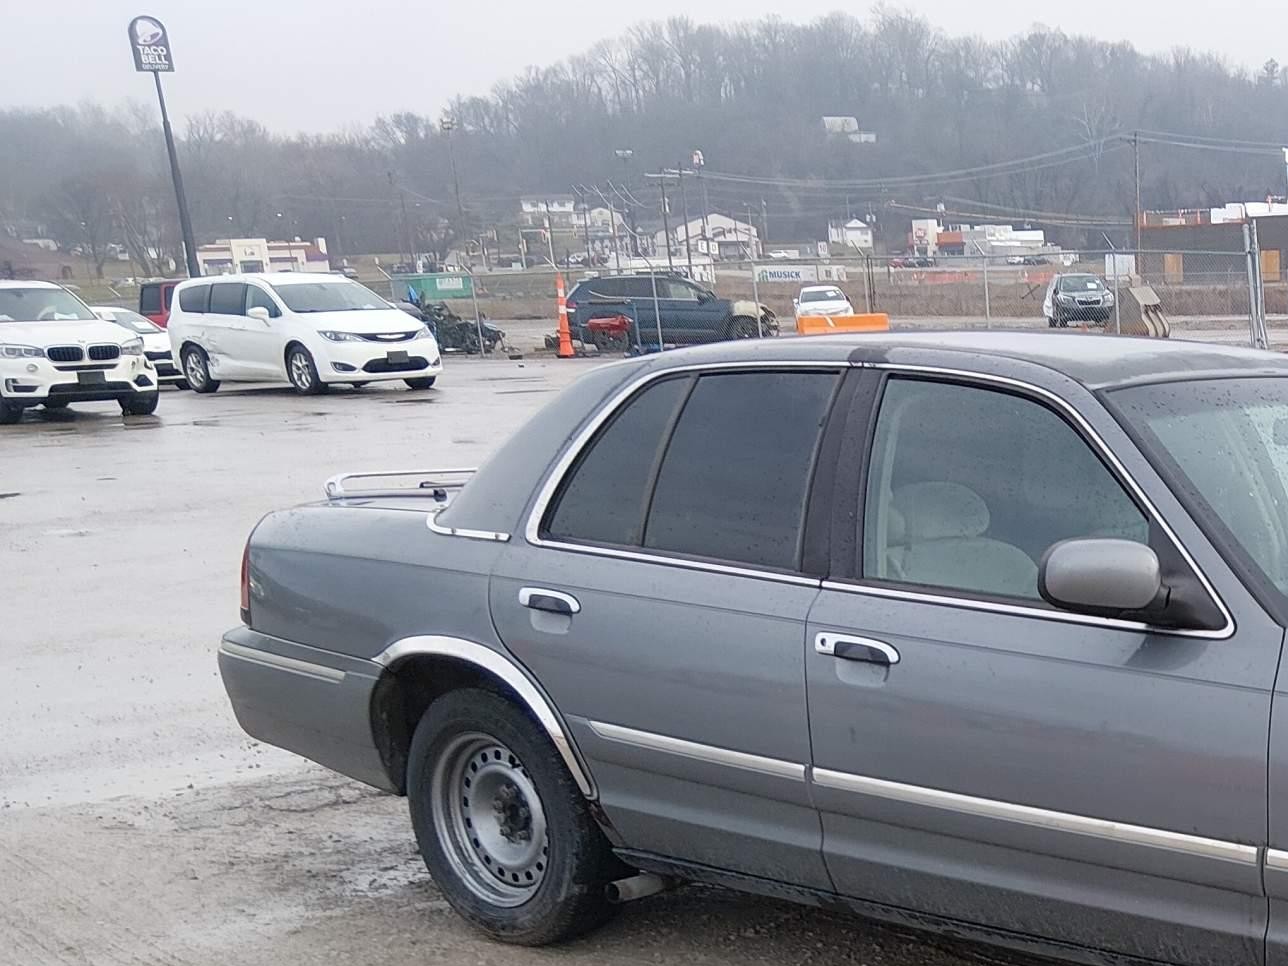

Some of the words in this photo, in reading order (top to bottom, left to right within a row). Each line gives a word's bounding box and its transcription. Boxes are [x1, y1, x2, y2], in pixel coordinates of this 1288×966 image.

[137, 45, 167, 55] TACO
[141, 54, 169, 64] BELL
[768, 271, 801, 279] MUSICK
